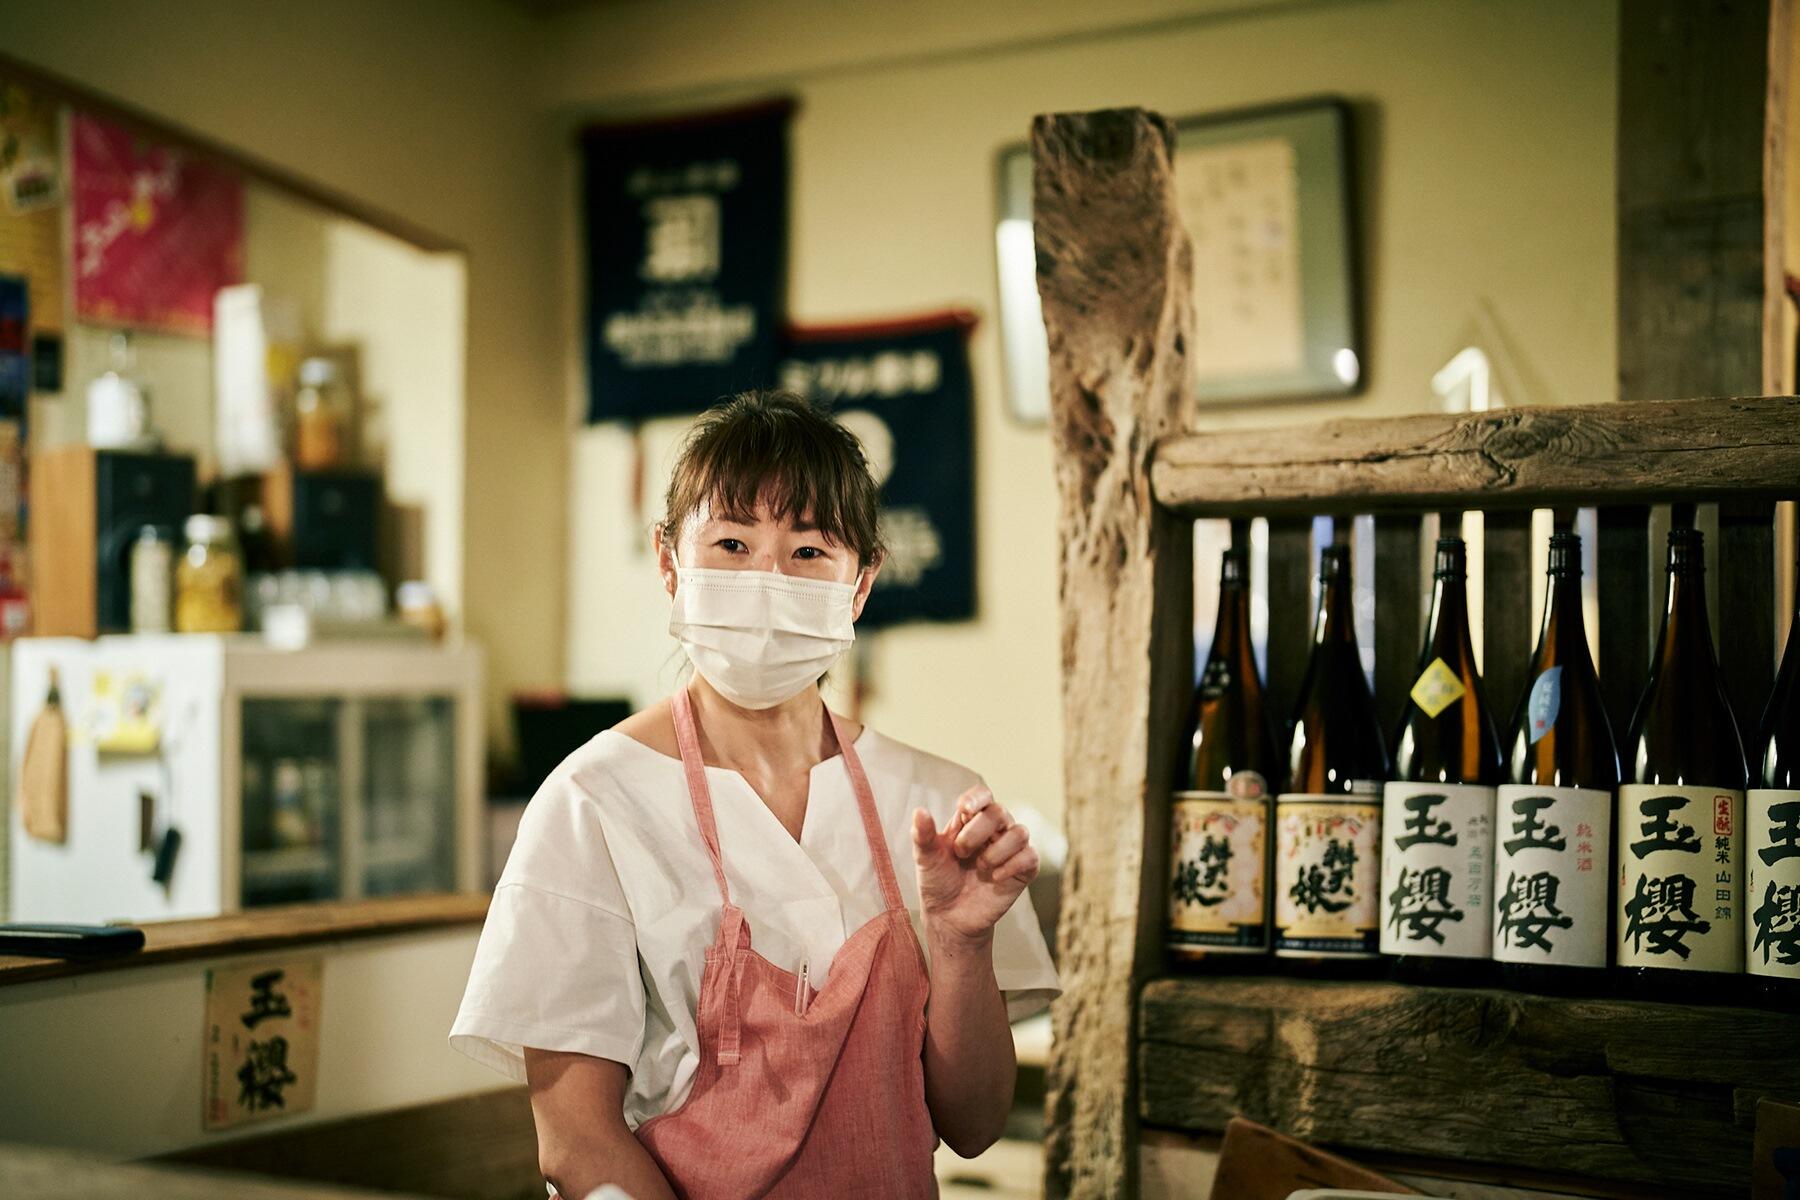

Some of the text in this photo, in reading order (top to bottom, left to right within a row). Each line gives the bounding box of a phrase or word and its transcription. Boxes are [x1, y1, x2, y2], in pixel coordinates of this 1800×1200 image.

[1497, 796, 1573, 954] 玉櫻
[1576, 823, 1592, 872] 純米酒
[1624, 796, 1712, 960] 玉櫻
